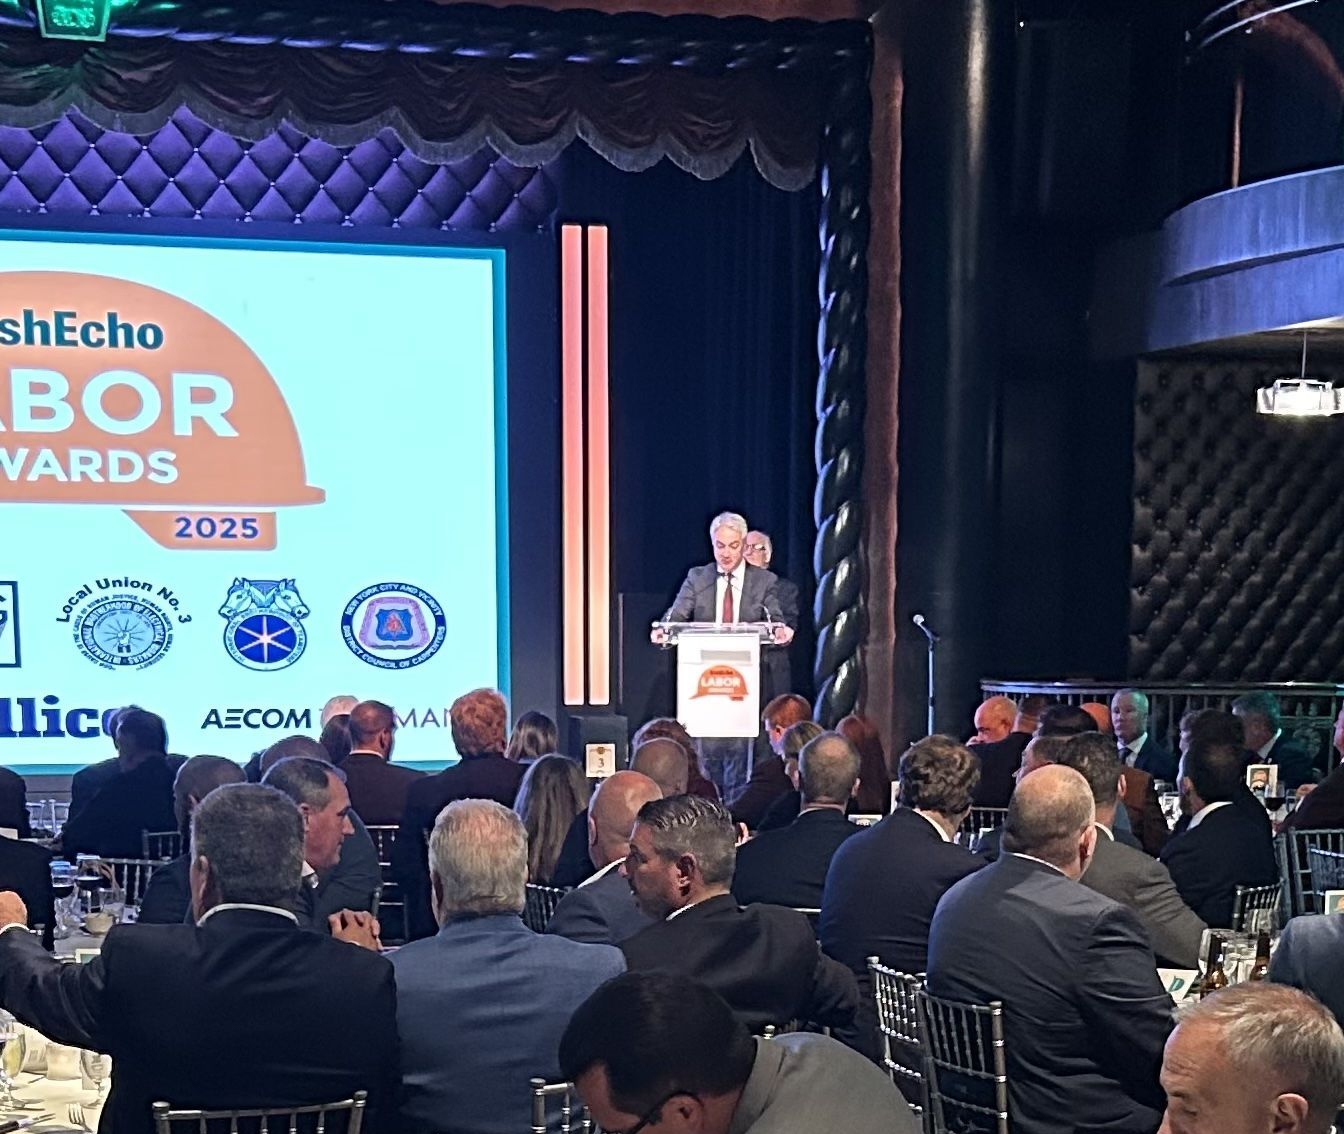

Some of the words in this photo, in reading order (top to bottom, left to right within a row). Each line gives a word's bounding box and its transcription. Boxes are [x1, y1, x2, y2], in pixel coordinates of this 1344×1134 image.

[175, 516, 259, 539] 2025
[56, 584, 93, 623] Local
[96, 576, 153, 592] Union
[157, 586, 180, 612] No.
[178, 614, 192, 624] 3
[357, 588, 379, 604] YORK
[400, 584, 418, 593] AND
[201, 708, 312, 729] AECOM
